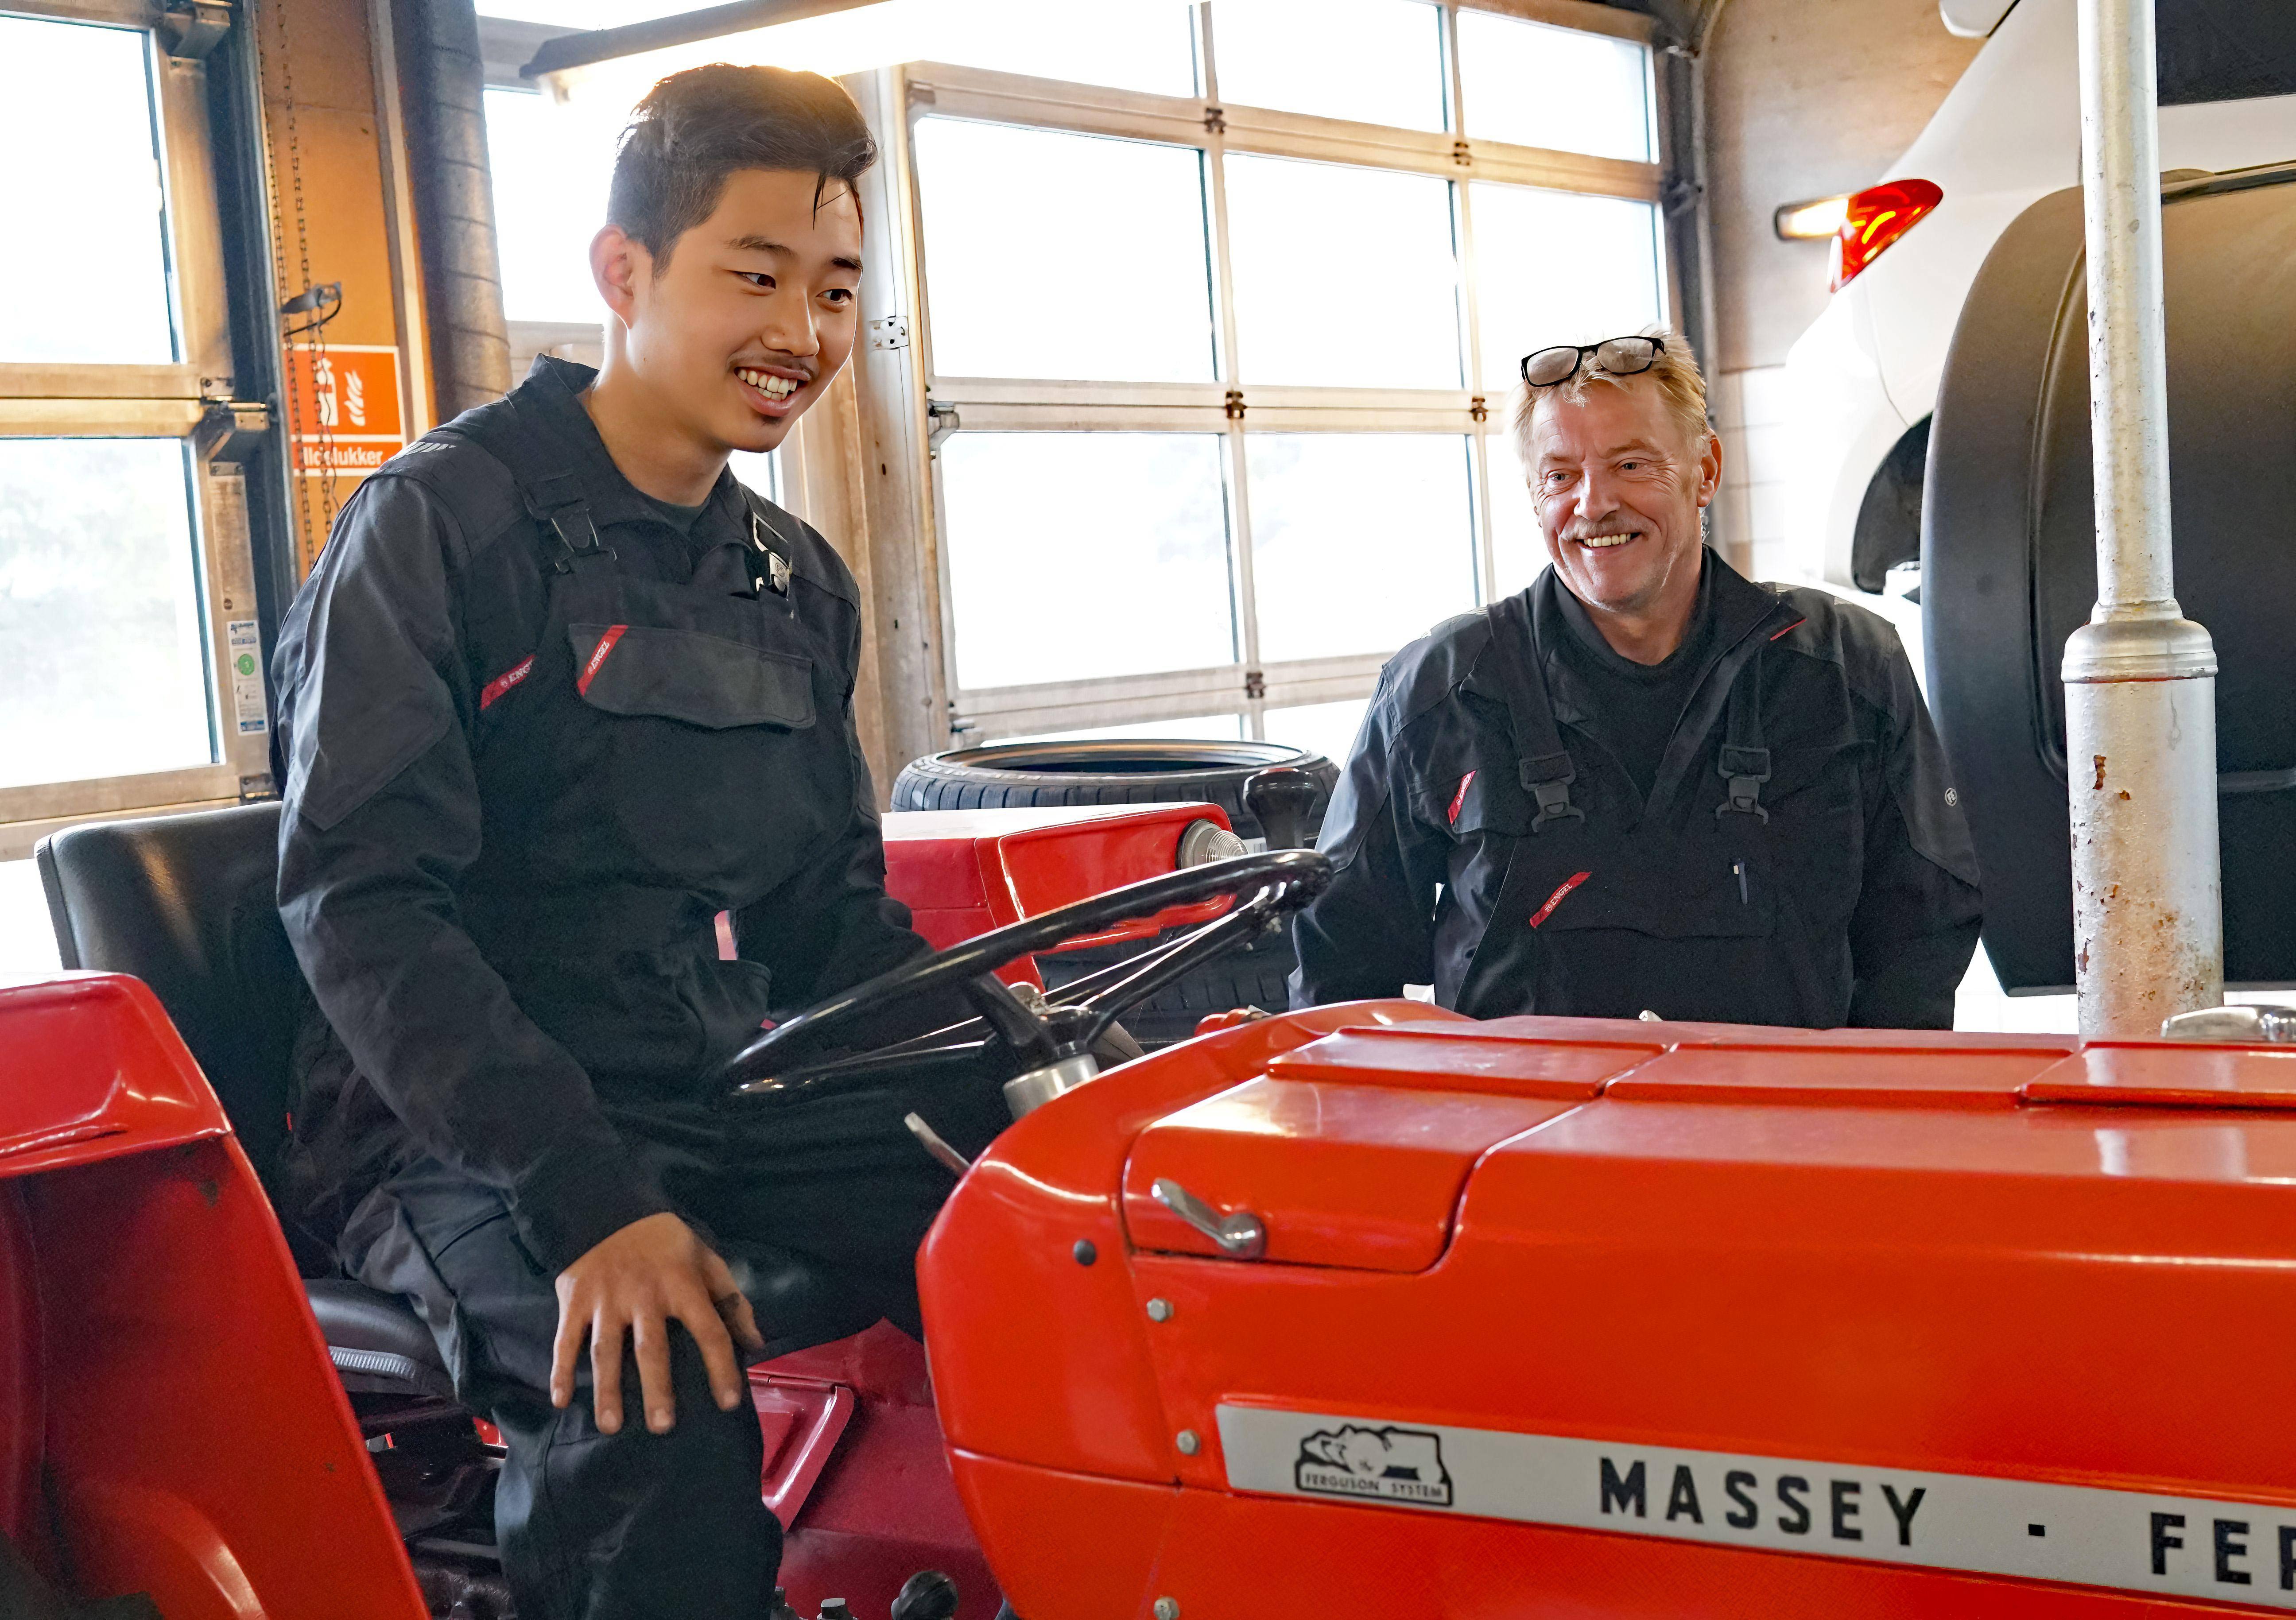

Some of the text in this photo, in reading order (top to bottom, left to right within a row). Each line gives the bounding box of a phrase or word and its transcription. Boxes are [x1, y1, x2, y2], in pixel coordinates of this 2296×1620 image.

[1305, 1473, 1443, 1497] FERGUSON SYSTEM
[1599, 1457, 1926, 1546] MASSEY
